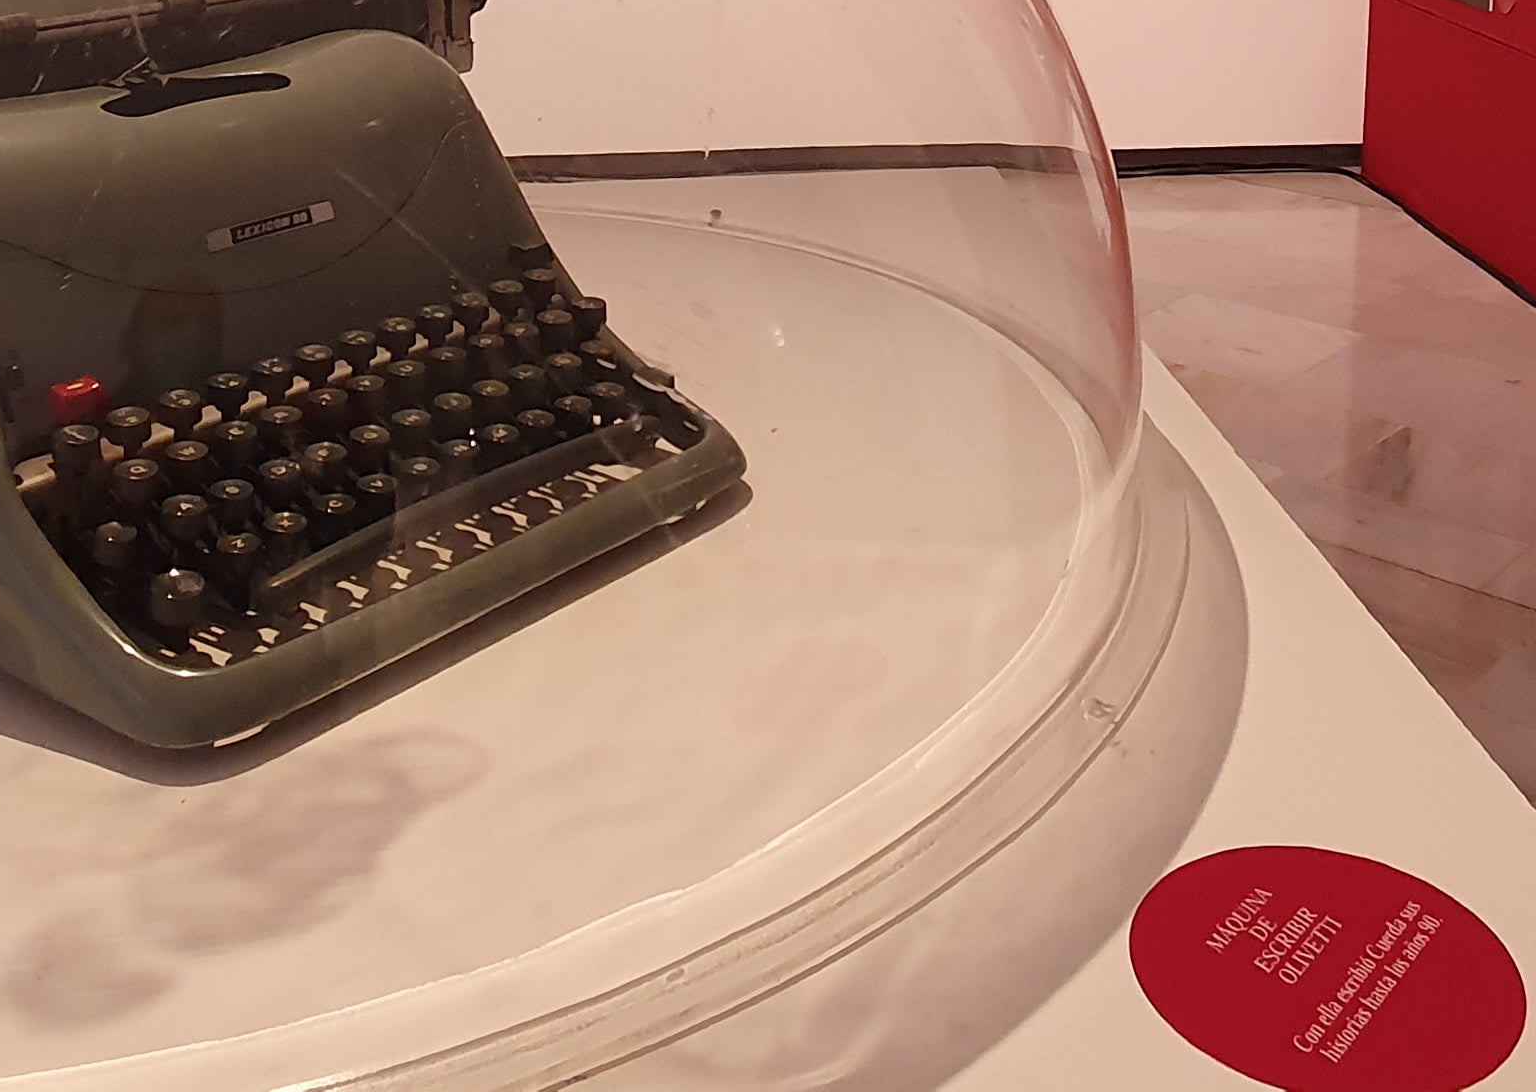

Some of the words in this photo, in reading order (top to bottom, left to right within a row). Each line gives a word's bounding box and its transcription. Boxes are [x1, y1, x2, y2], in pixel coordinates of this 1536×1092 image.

[1206, 887, 1273, 954] MÁQUINA
[1248, 916, 1278, 942] DE
[1254, 907, 1318, 973] ESCRIBIR
[1278, 915, 1342, 985] OLIVETTI
[1293, 1023, 1326, 1053] Con
[1316, 1001, 1344, 1026] ella
[1336, 955, 1377, 1004] escribió
[1365, 918, 1407, 960] Cuerda
[1399, 900, 1421, 922] sus
[1319, 1007, 1373, 1063] historias
[1358, 975, 1398, 1010] hasta
[1384, 958, 1411, 979] los
[1402, 932, 1431, 961] años
[1417, 914, 1444, 935] 90.
